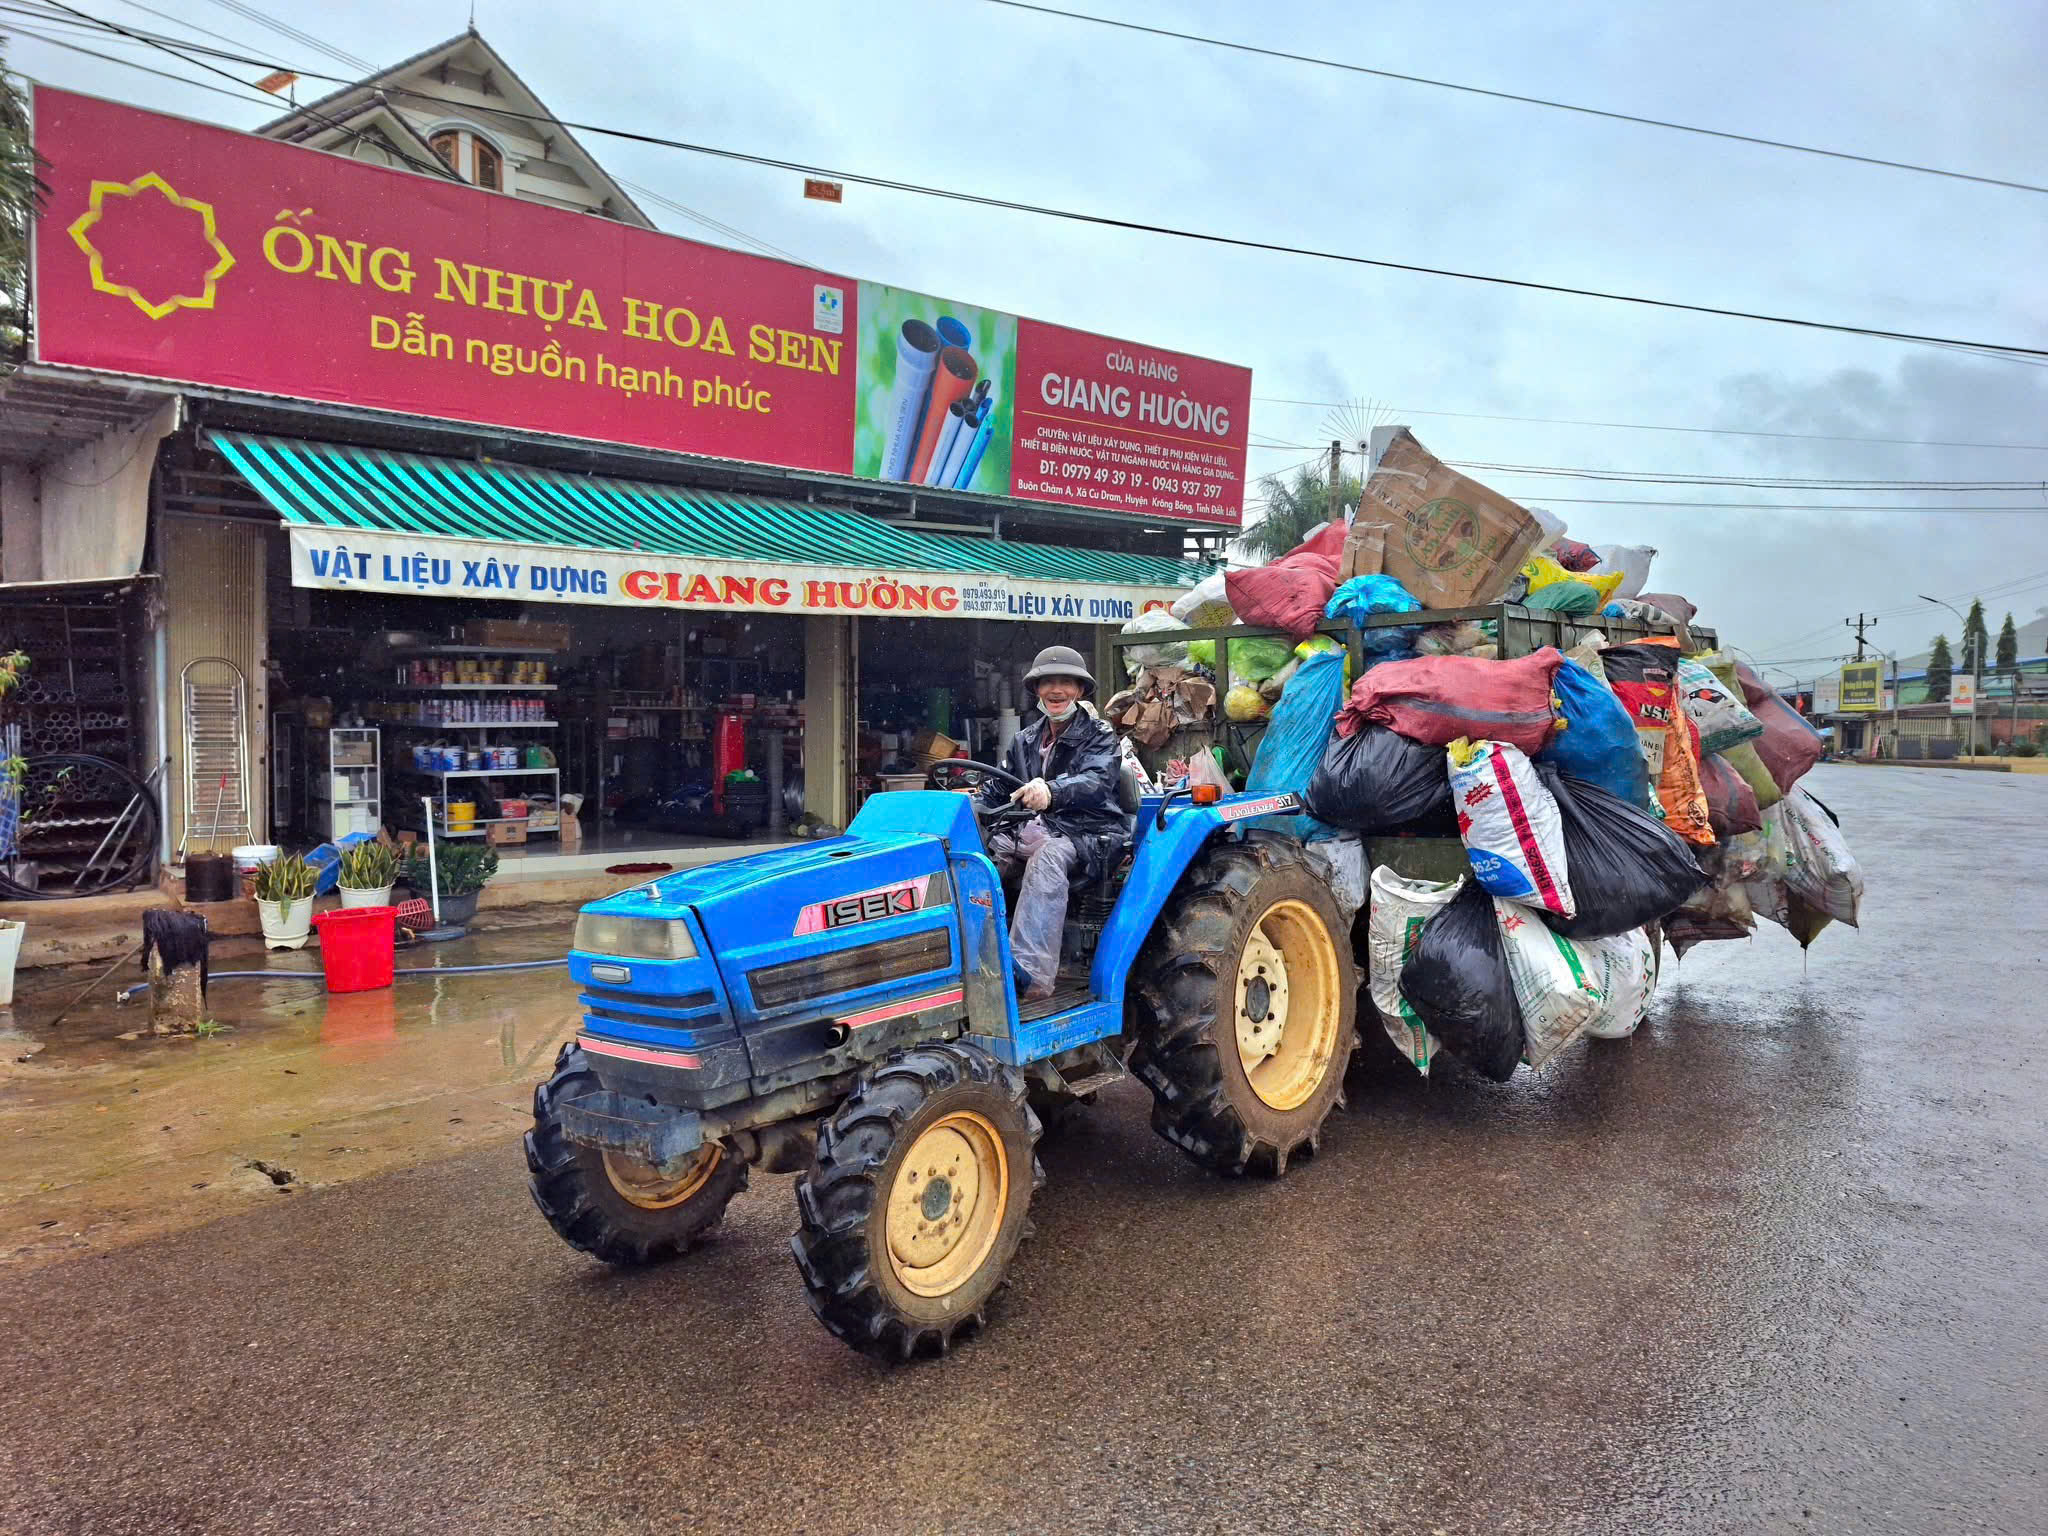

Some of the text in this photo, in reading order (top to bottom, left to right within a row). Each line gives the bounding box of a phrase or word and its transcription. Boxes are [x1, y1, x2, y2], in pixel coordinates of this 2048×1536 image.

[262, 207, 844, 376] ỐNG NHỰA HOA SEN
[370, 311, 772, 414] Dẫn nguồn hạnh phúc
[1106, 349, 1179, 383] CỬA HÀNG
[1040, 372, 1230, 436] GIANG HƯỜNG
[1020, 438, 1040, 450] THIẾT
[1041, 442, 1049, 454] BỊ
[1050, 443, 1068, 456] ĐIỆN
[1096, 449, 1110, 462] VẬT
[1121, 454, 1148, 468] NGÀNH
[1171, 461, 1181, 472] VÀ
[1182, 462, 1202, 476] HÀNG
[1202, 467, 1215, 477] GIA
[1037, 426, 1070, 441] CHUYÊN:
[1072, 431, 1087, 445] VẬT
[1088, 434, 1102, 447] LIỆU
[1103, 436, 1118, 449] XÂY
[1144, 443, 1162, 456] THIẾT
[1184, 450, 1200, 462] KIỆN
[1200, 453, 1213, 465] VẬT
[1018, 479, 1039, 491] Buôn
[1040, 482, 1063, 496] Chàm
[1064, 486, 1074, 497] A,
[1076, 487, 1087, 498] Xã
[1125, 493, 1148, 508] Huyện
[1152, 497, 1174, 512] Krông
[1040, 460, 1059, 477] ĐT:
[1062, 463, 1091, 480] 0979
[1094, 468, 1109, 483] 49
[1111, 470, 1126, 486] 39
[1130, 473, 1142, 488] 19
[1152, 476, 1179, 493] 0943
[1181, 480, 1200, 496] 937
[1203, 484, 1222, 499] 397
[309, 545, 607, 597] VẬT LIỆU XÂY DỰNG
[619, 570, 960, 615] GIANG HƯỜNG
[962, 588, 1006, 600] 0979.493.919
[963, 600, 1006, 612] 0943.937.397
[1008, 591, 1046, 619] LIỆU
[1051, 594, 1085, 617] XÂY
[1089, 599, 1133, 622] DỰNG
[1275, 795, 1293, 808] 317
[825, 886, 921, 928] ISEKI
